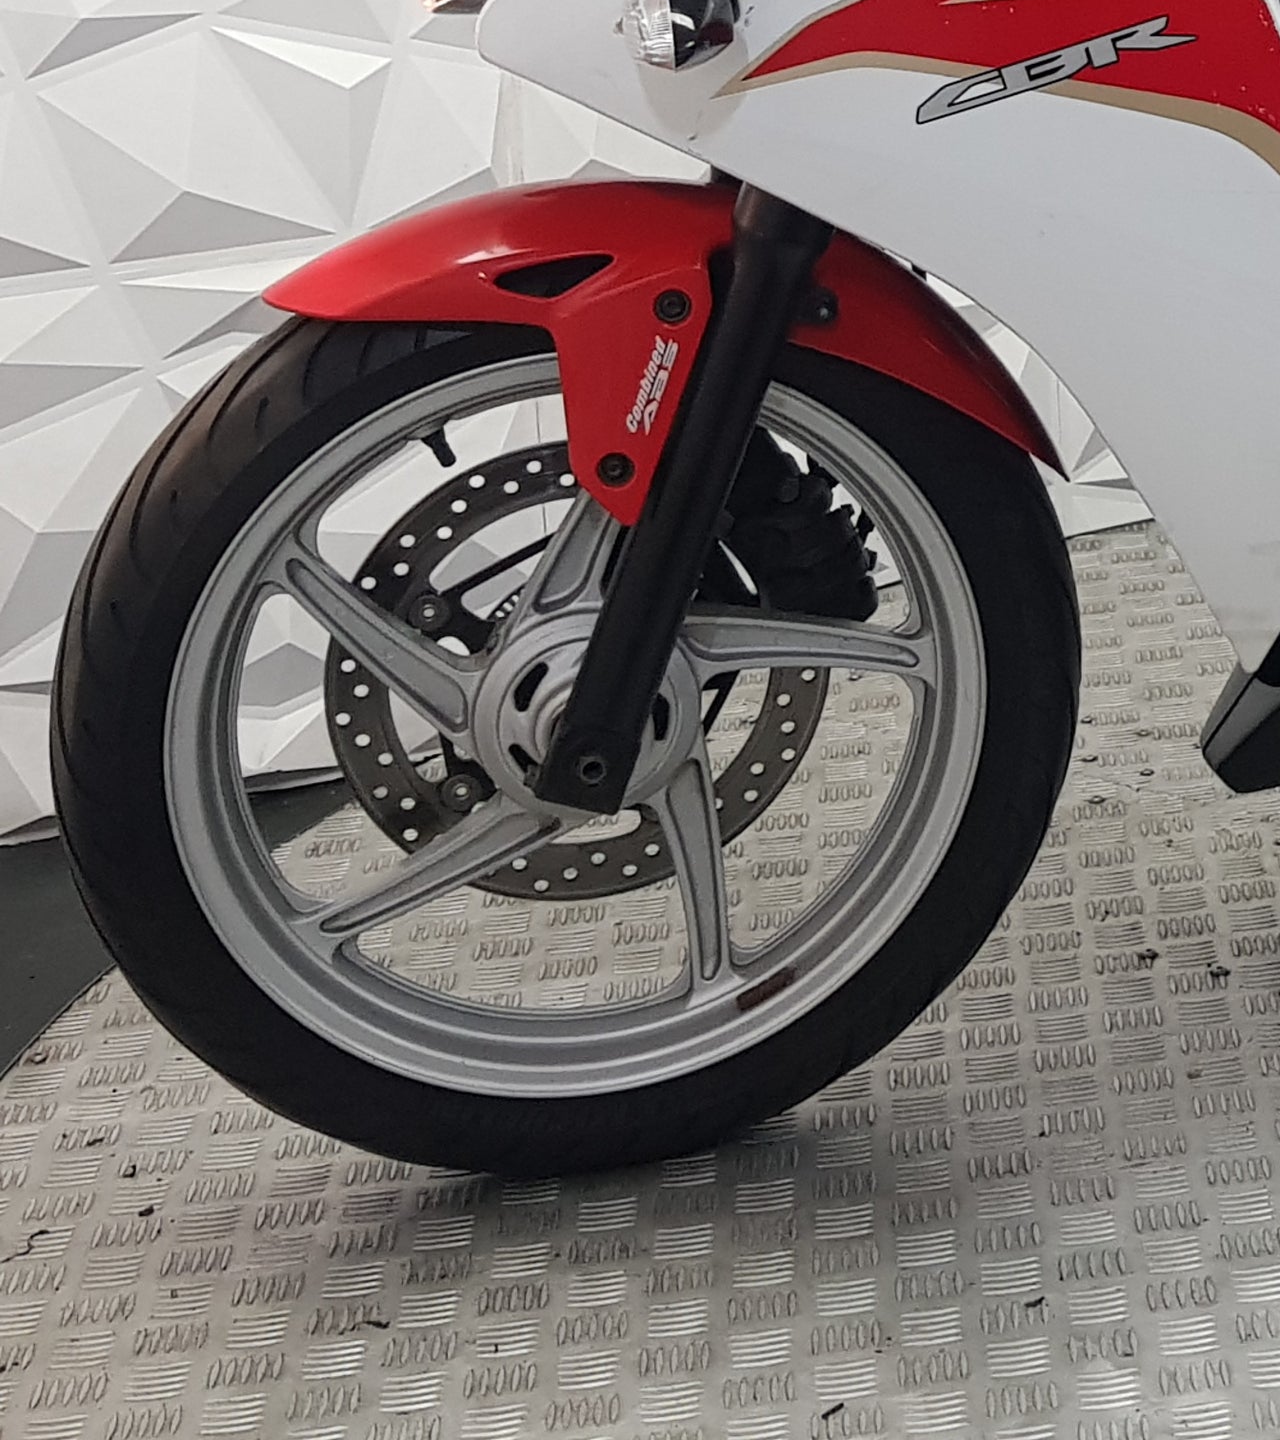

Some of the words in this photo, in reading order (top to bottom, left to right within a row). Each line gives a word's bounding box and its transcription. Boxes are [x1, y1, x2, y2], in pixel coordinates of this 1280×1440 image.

[915, 14, 1198, 125] CBR
[626, 334, 667, 434] Combined
[643, 338, 680, 436] ABS
